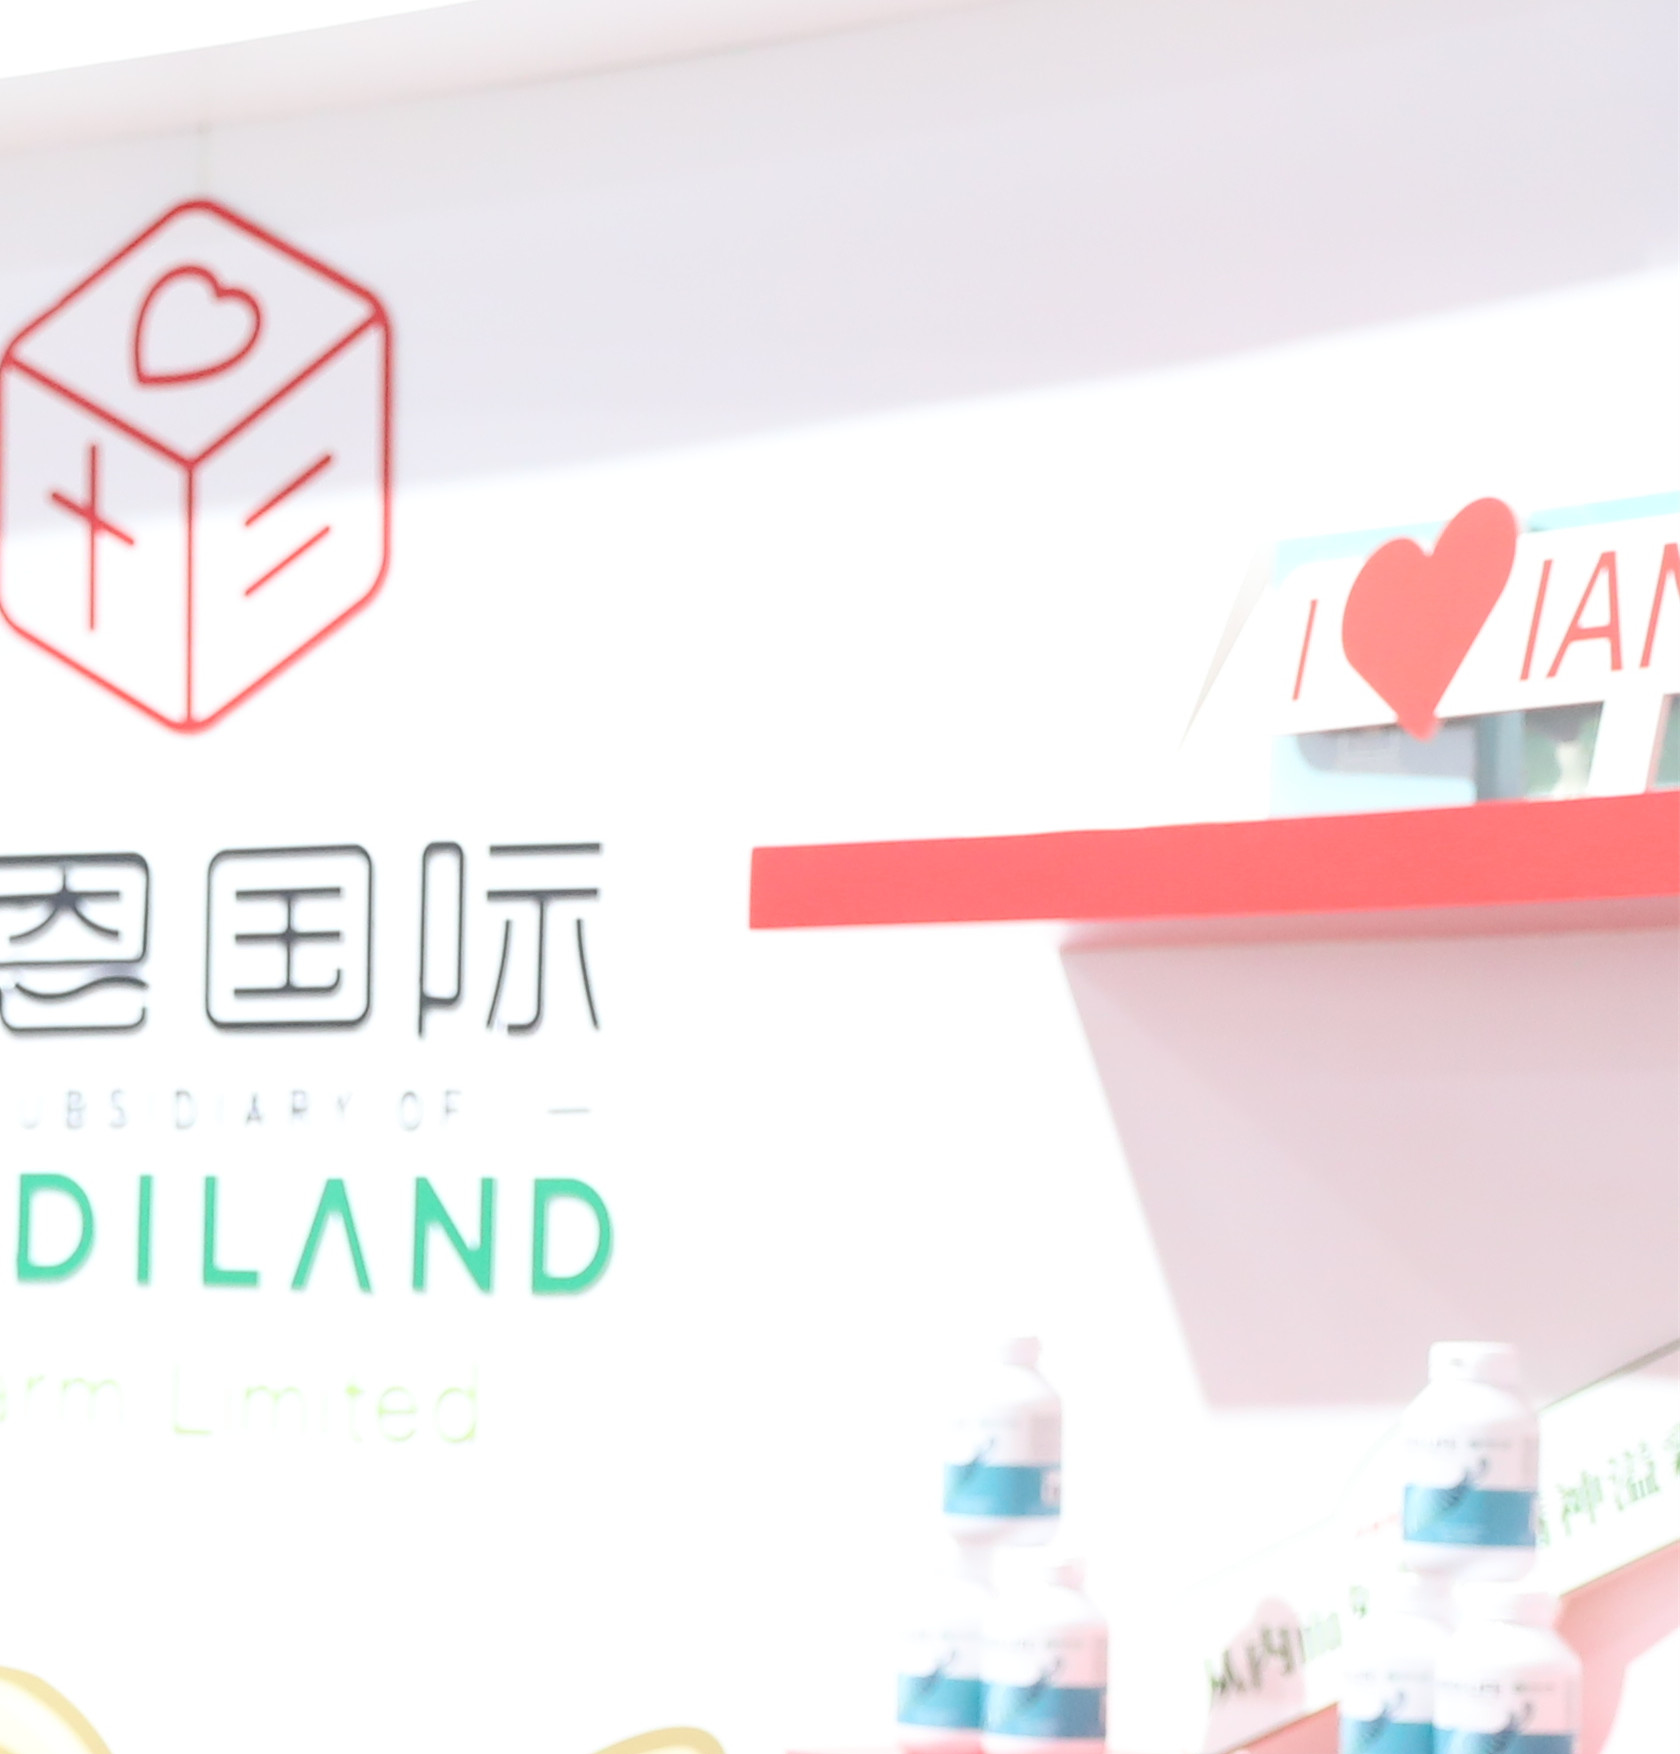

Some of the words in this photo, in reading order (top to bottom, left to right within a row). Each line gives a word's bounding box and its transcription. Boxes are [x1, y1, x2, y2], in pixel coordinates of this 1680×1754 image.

[1292, 598, 1318, 702] I
[398, 1088, 464, 1133] OF
[169, 1360, 481, 1445] Limited
